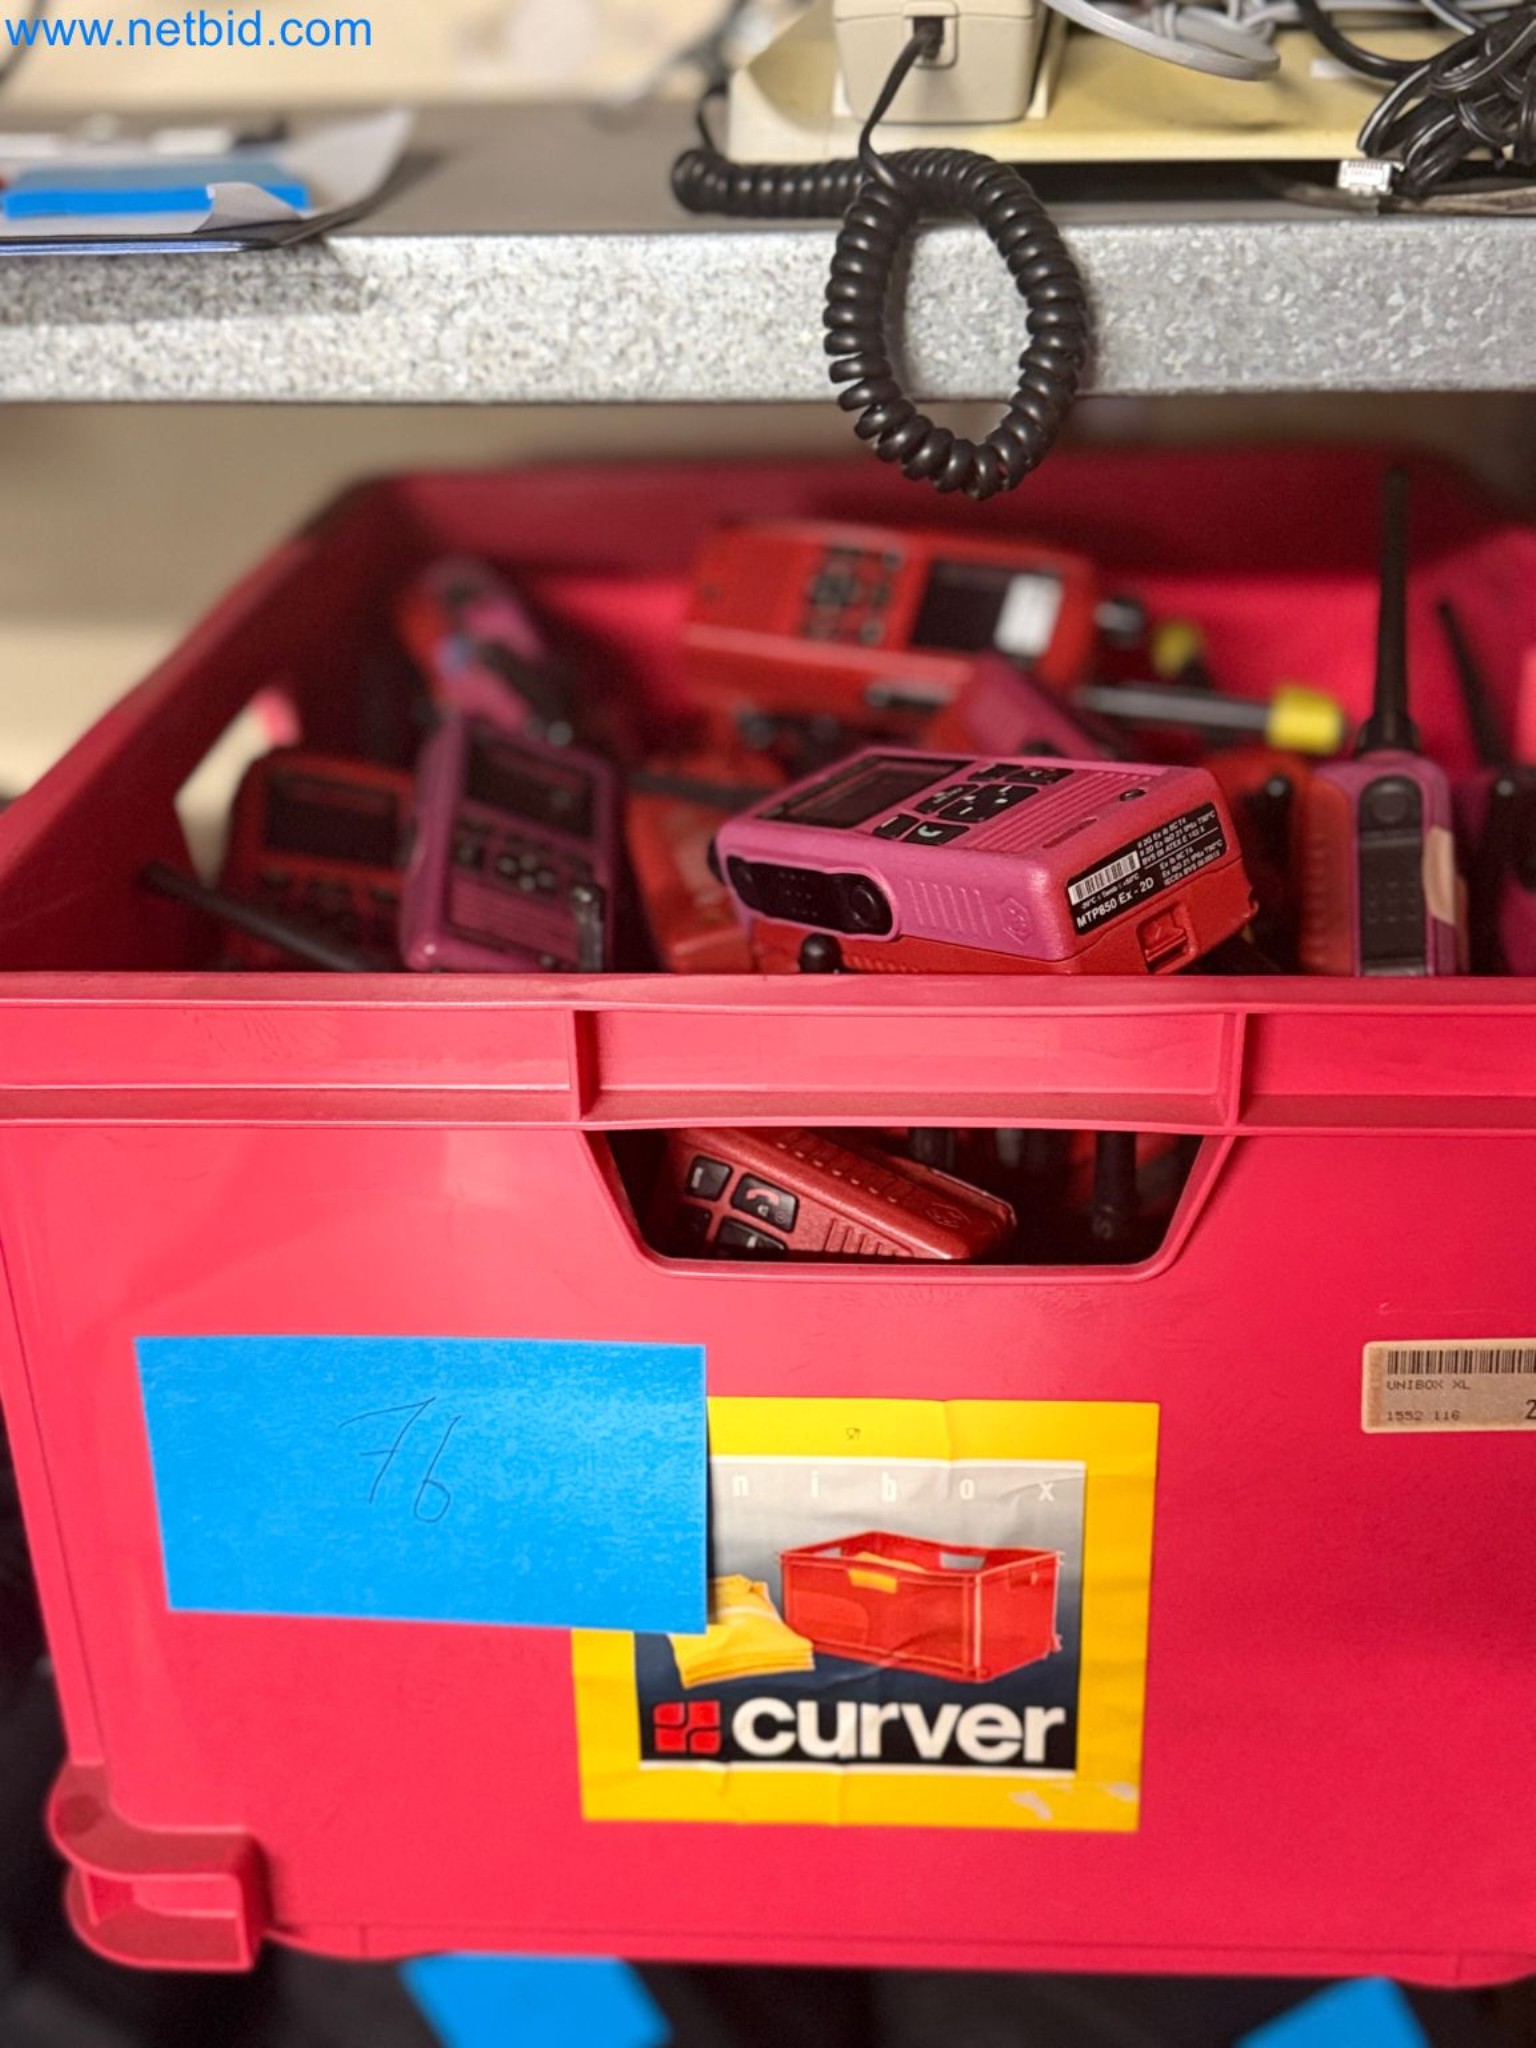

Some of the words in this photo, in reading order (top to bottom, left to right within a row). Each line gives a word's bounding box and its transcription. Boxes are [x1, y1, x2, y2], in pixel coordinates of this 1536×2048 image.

[1077, 898, 1117, 927] MTP850
[1118, 891, 1132, 904] Ex
[1139, 877, 1154, 892] 2D
[1386, 1379, 1443, 1391] UNIBOX
[1452, 1379, 1471, 1390] XL
[338, 1395, 461, 1523] 76
[732, 1472, 1056, 1502] nibox
[732, 1696, 1066, 1762] curver
